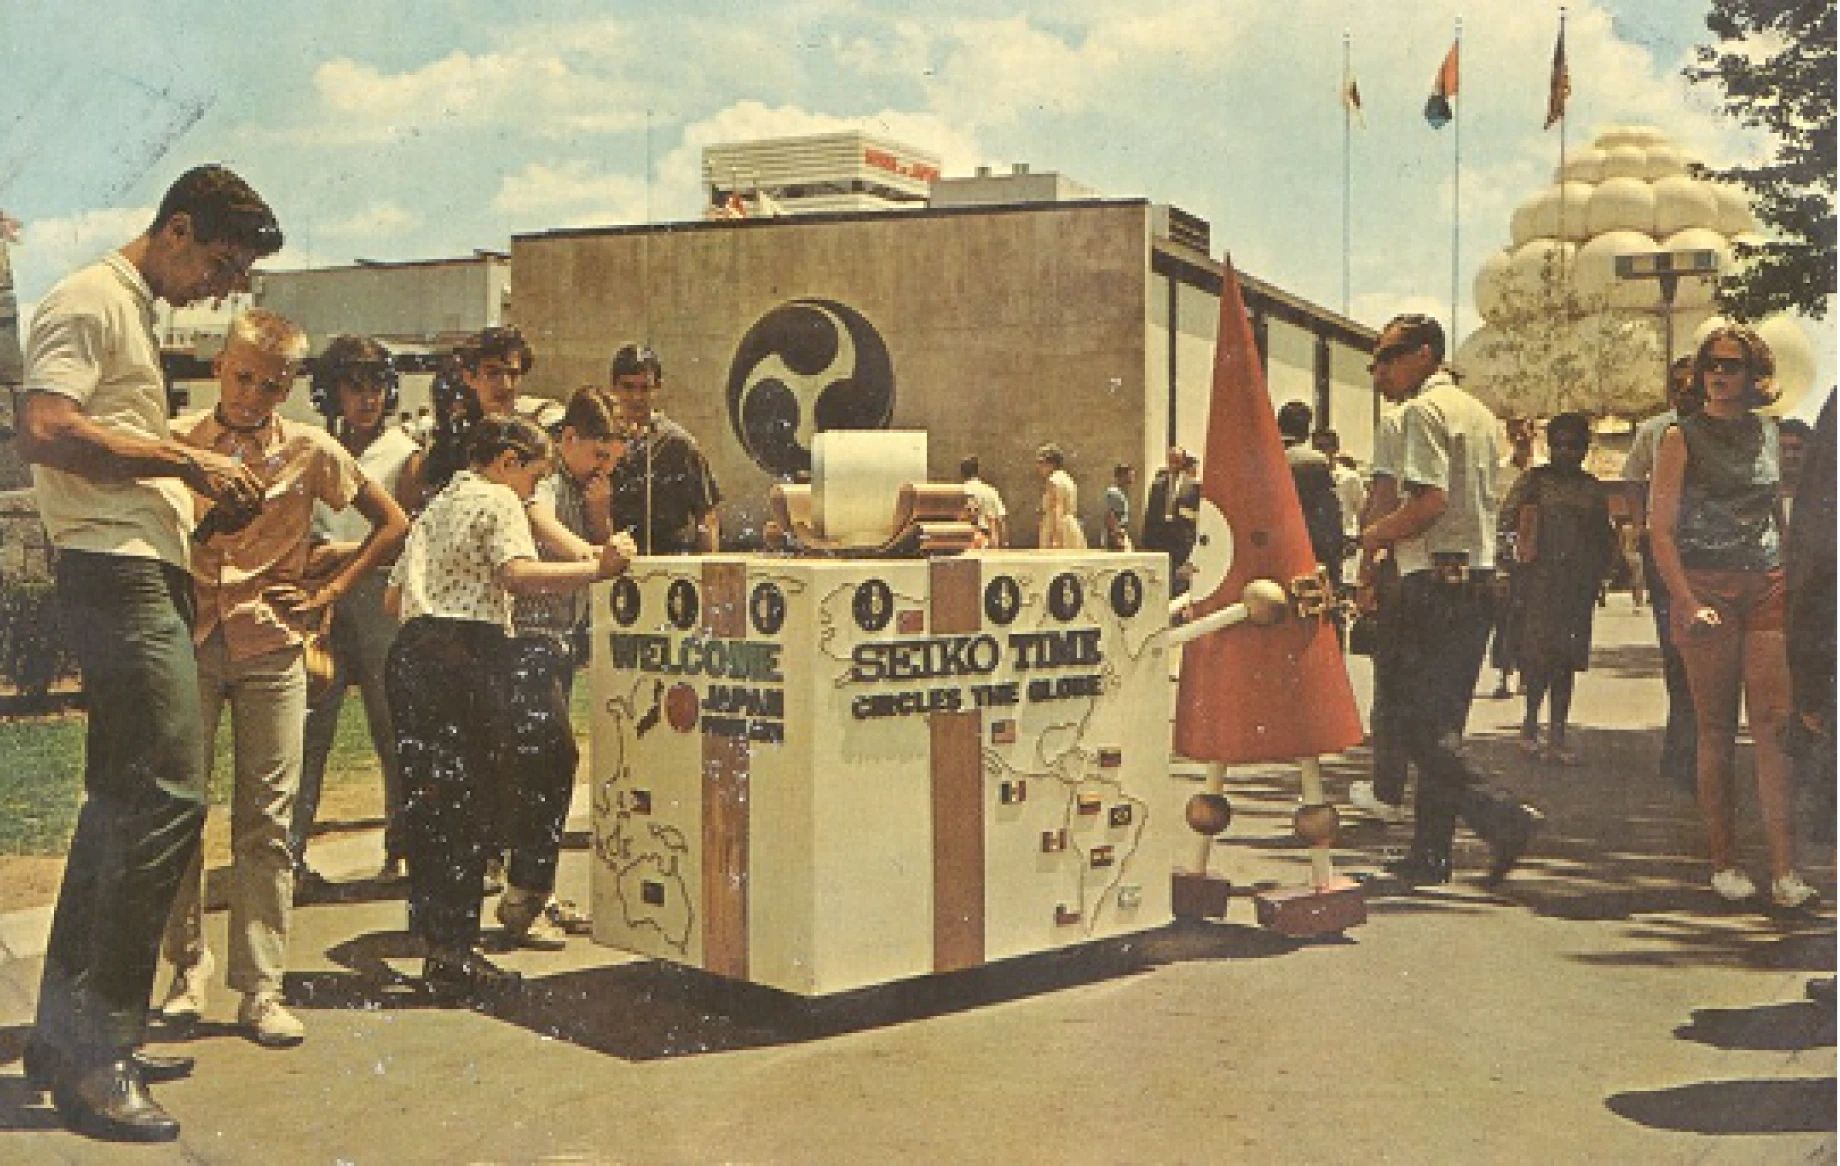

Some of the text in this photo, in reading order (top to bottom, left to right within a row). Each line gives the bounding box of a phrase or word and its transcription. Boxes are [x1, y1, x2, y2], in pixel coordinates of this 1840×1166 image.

[609, 633, 784, 682] WELCOME
[852, 627, 1101, 682] SEIKO TIME
[851, 675, 1104, 717] CIRCLES THE GLOBE
